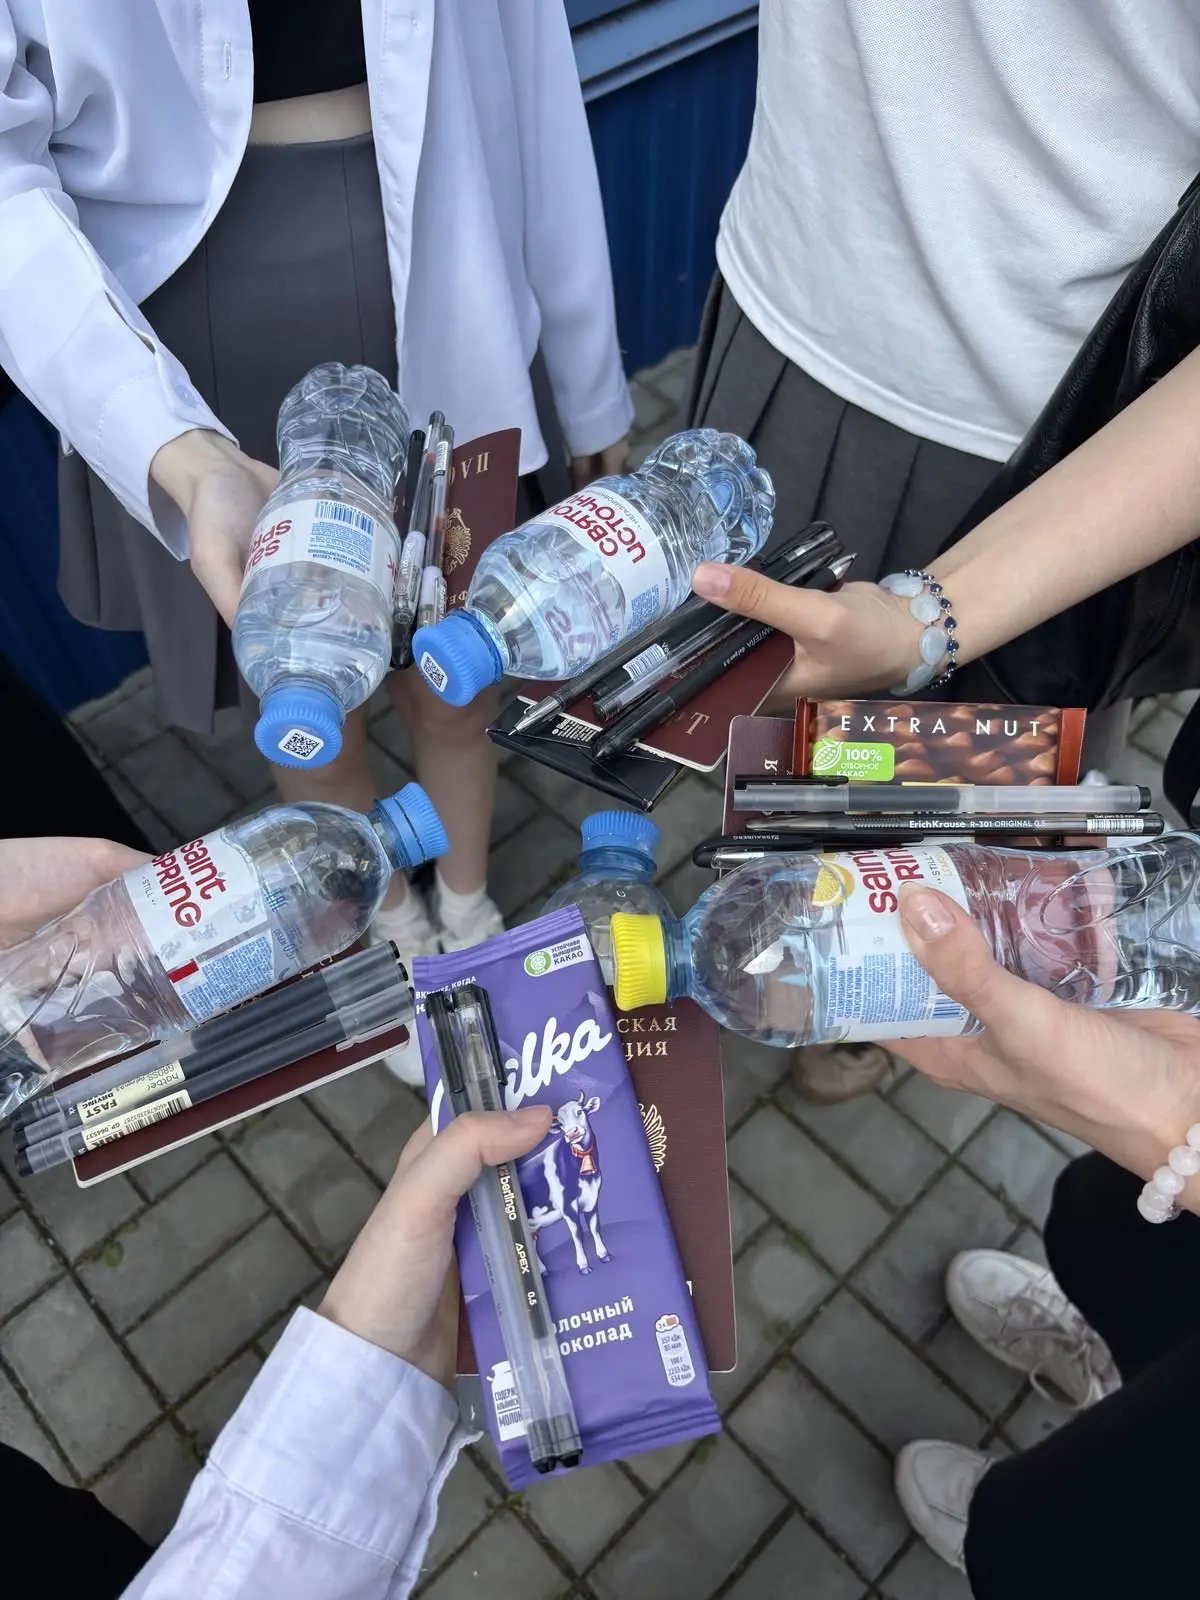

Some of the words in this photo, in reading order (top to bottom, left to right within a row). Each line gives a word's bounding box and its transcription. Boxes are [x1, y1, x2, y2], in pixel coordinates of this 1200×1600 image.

[841, 715, 947, 734] EXTRA
[976, 720, 1040, 736] NUT
[846, 749, 882, 761] 100%
[909, 820, 966, 828] ErichKrause
[180, 838, 226, 899] saint
[886, 850, 924, 881] RIN
[925, 856, 940, 875] STILL
[141, 879, 154, 898] STILL
[152, 849, 200, 927] SPRING
[551, 939, 580, 953] УСТОЙЧИВО
[554, 950, 584, 965] КАКАО
[451, 976, 477, 989] КОГДА
[853, 991, 861, 1012] ВКУСОМ
[146, 1073, 179, 1091] hatber
[82, 1092, 114, 1109] DRYING
[84, 1099, 118, 1118] FAST
[500, 1175, 518, 1221] berlingo
[515, 1242, 530, 1274] APEX
[527, 1291, 538, 1306] 0.5
[552, 1296, 634, 1334] олочный
[560, 1323, 633, 1356] околад
[670, 1357, 680, 1365] 100
[668, 1367, 680, 1375] 2233
[671, 1375, 681, 1383] 534
